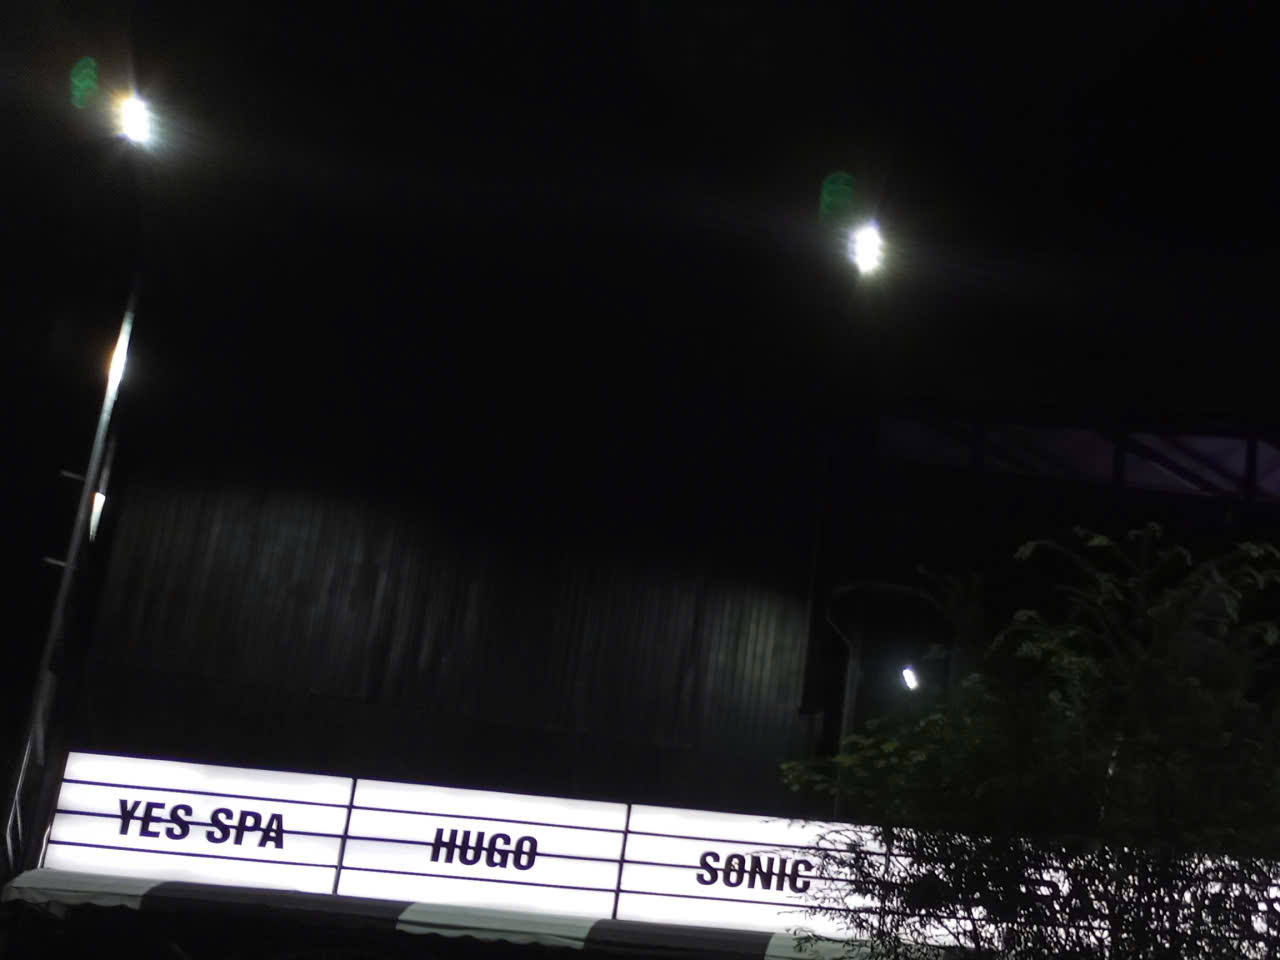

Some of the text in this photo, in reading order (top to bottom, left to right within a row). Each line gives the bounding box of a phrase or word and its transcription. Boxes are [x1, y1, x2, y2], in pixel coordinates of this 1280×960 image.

[117, 799, 284, 849] YES SPA
[430, 827, 537, 869] HUGO
[696, 851, 813, 893] SONIC
